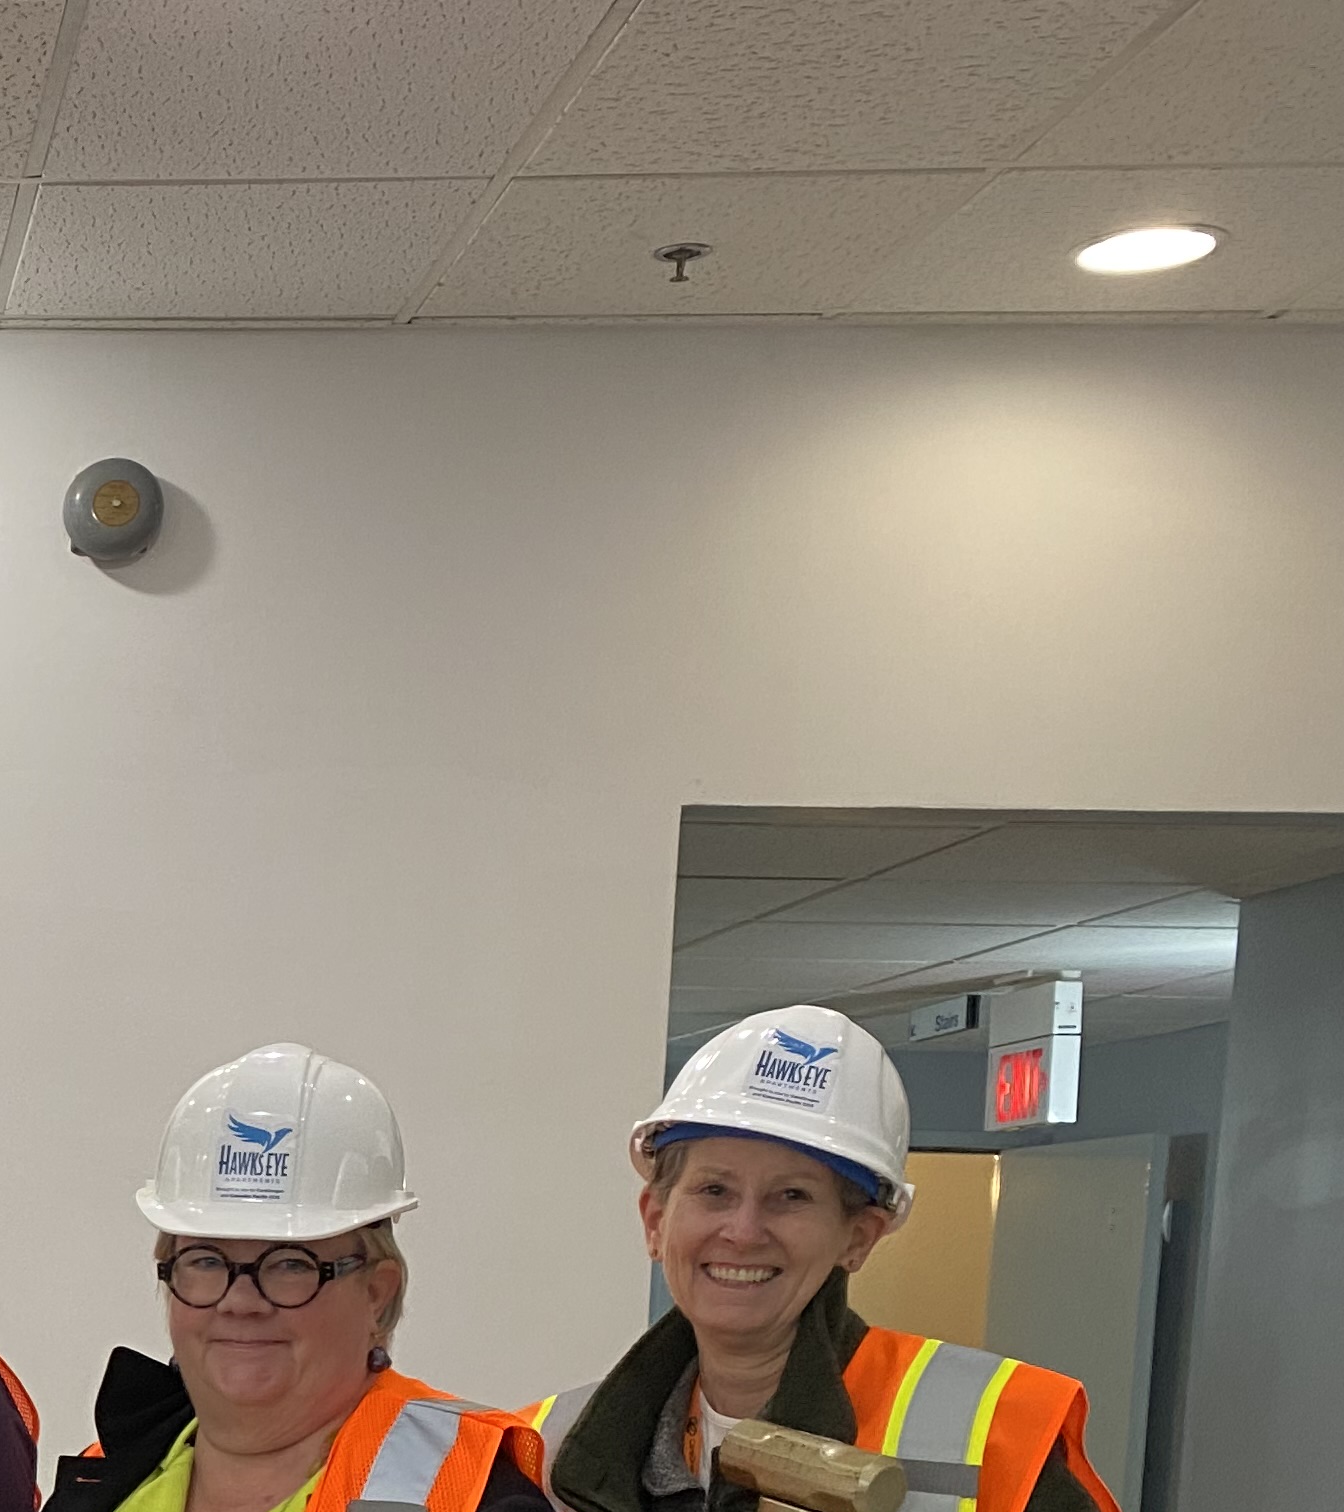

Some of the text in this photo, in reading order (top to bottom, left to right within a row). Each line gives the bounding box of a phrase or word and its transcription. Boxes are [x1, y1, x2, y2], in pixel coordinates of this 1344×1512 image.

[803, 1065, 832, 1090] EYE
[995, 1047, 1044, 1123] EXIT
[265, 1152, 290, 1177] EYE
